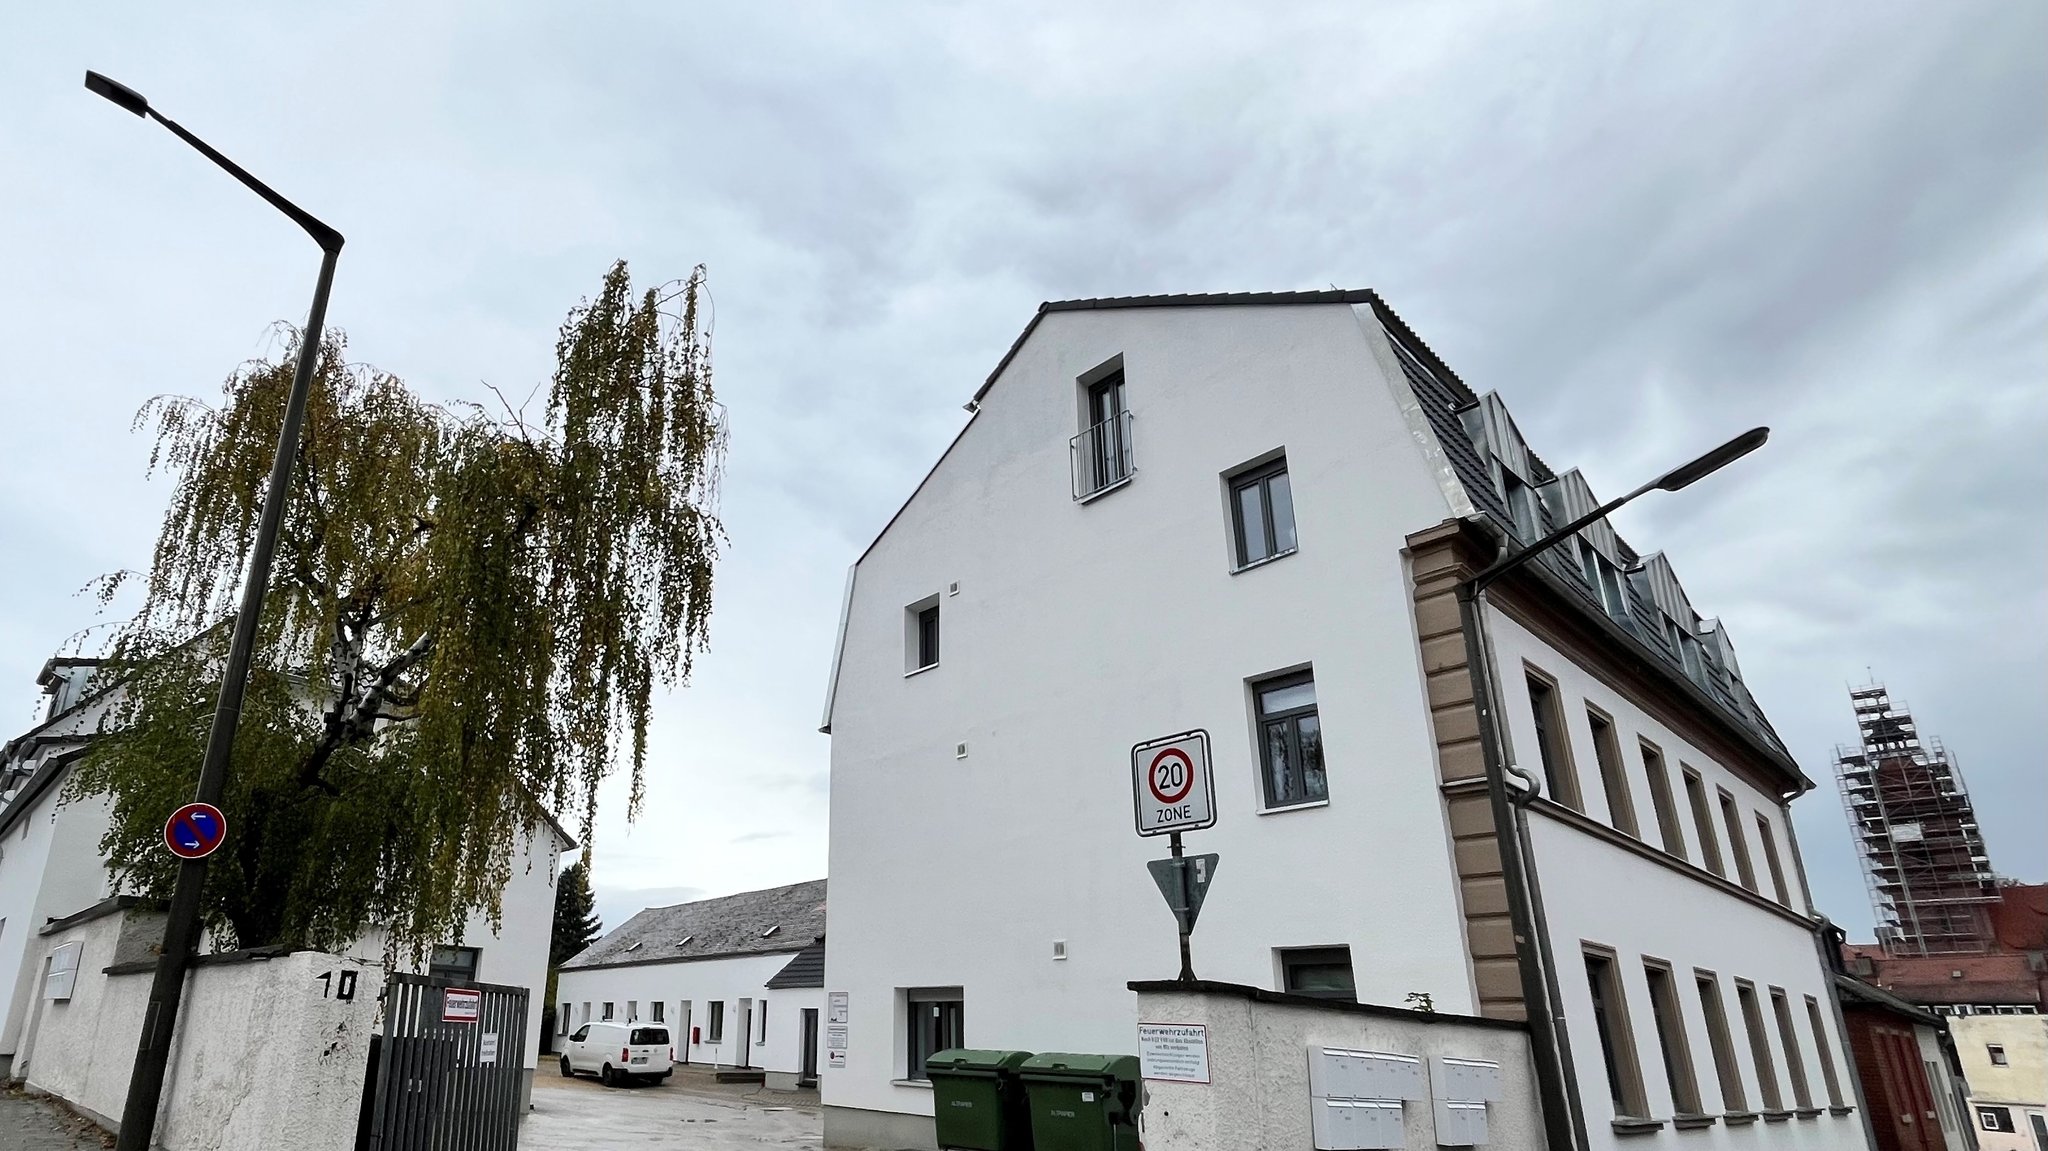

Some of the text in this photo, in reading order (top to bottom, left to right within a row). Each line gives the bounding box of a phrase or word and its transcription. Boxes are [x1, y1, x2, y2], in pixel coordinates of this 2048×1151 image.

[1158, 763, 1183, 790] 20
[1156, 805, 1191, 823] ZONE
[315, 970, 358, 1000] 10
[1140, 1027, 1204, 1037] Feuerwehrzufahrt
